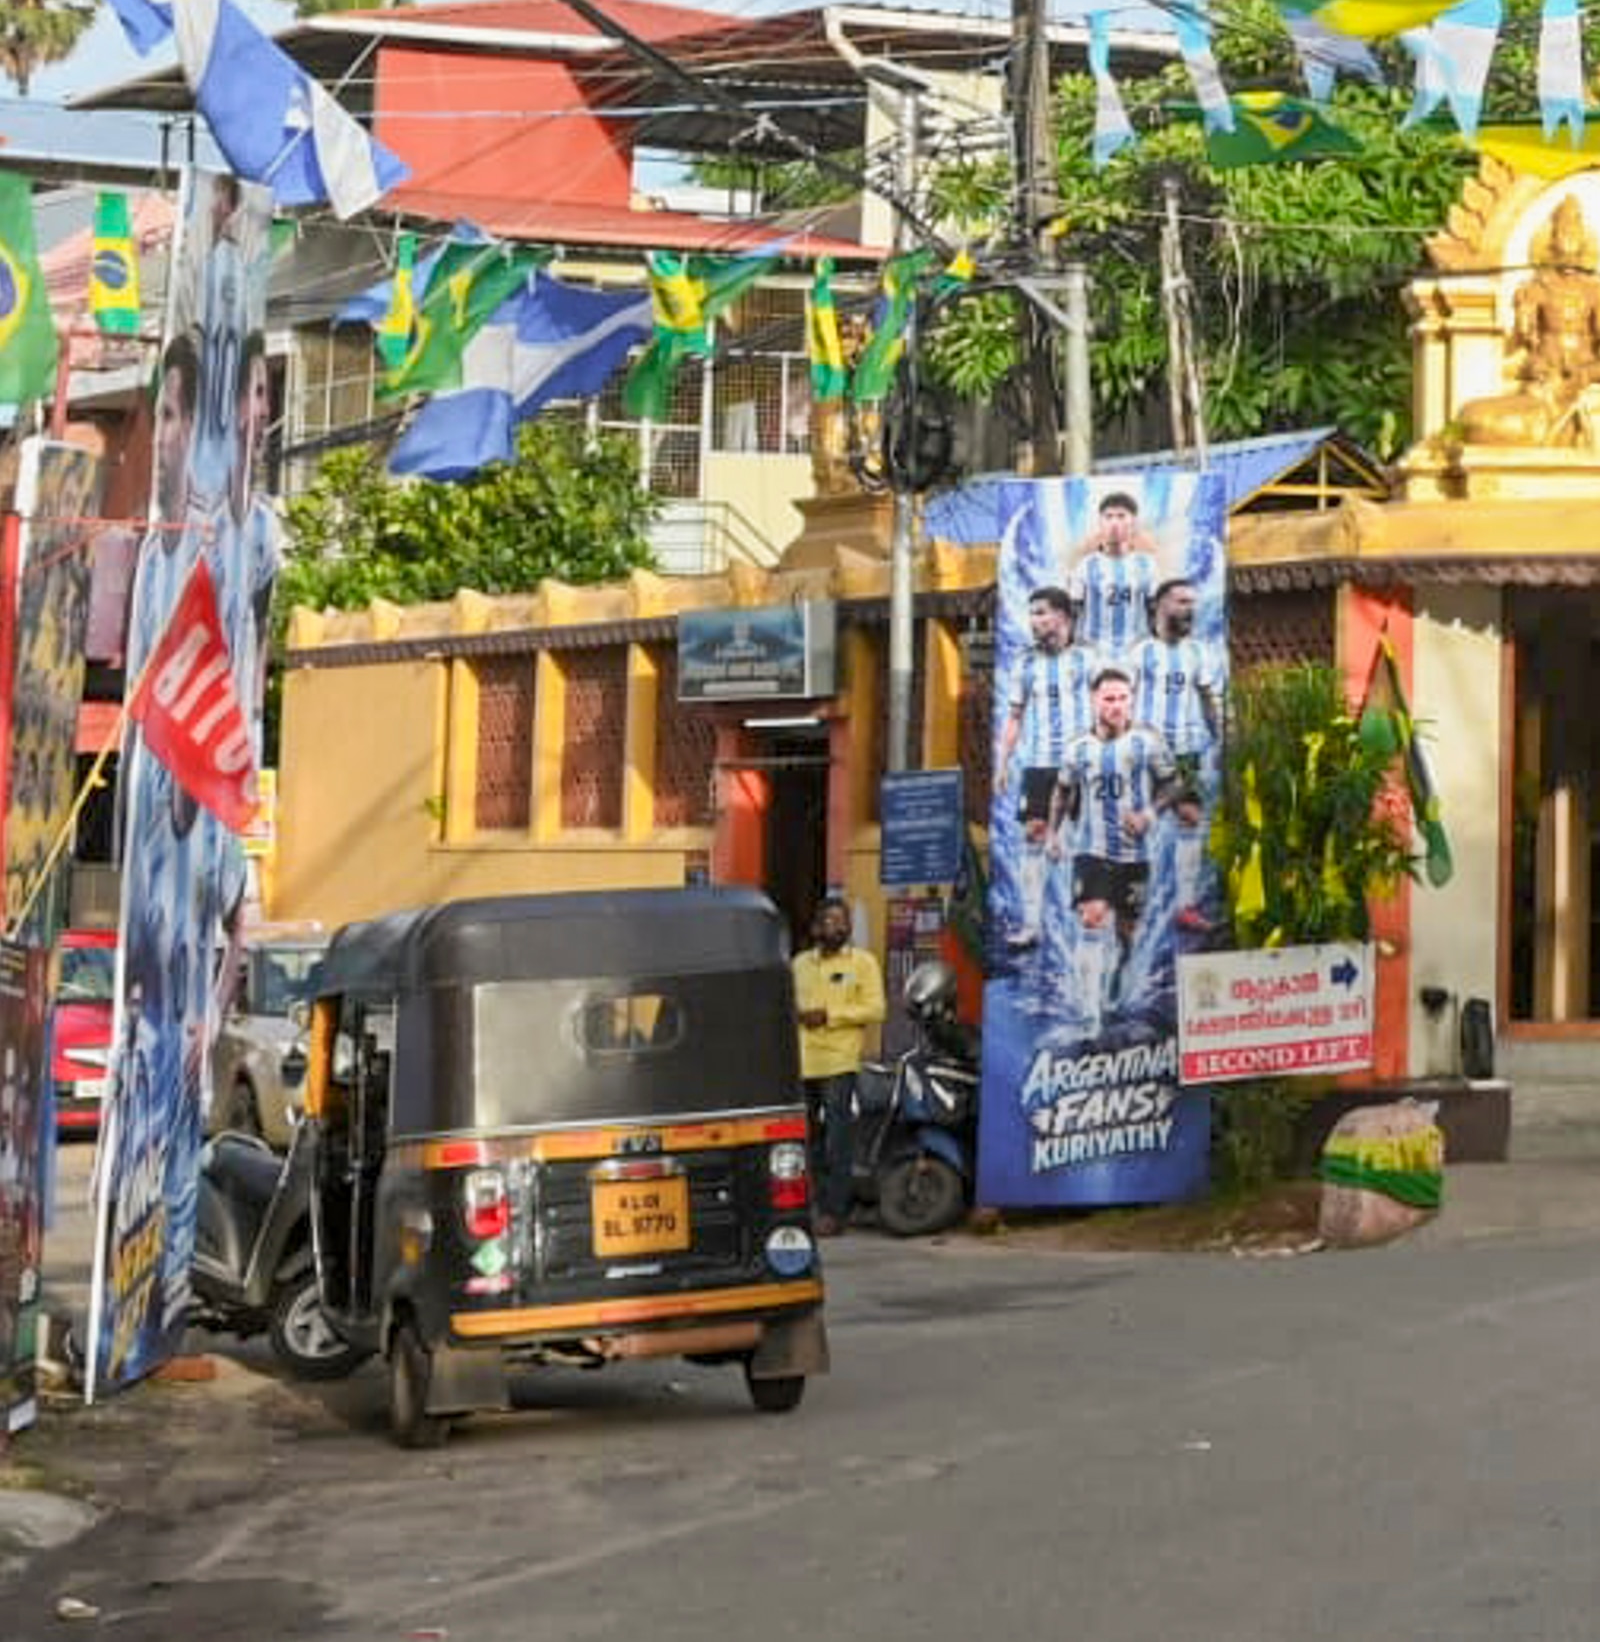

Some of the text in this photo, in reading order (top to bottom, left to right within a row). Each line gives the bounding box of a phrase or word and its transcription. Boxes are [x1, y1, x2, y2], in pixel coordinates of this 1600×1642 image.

[1107, 585, 1132, 606] 24
[1094, 772, 1124, 801] 20
[1021, 1037, 1177, 1105] ARGENTINA
[1195, 1037, 1363, 1075] SECOND LEFT
[1054, 1082, 1157, 1135] FANS
[1032, 1118, 1173, 1173] KURIYATHY
